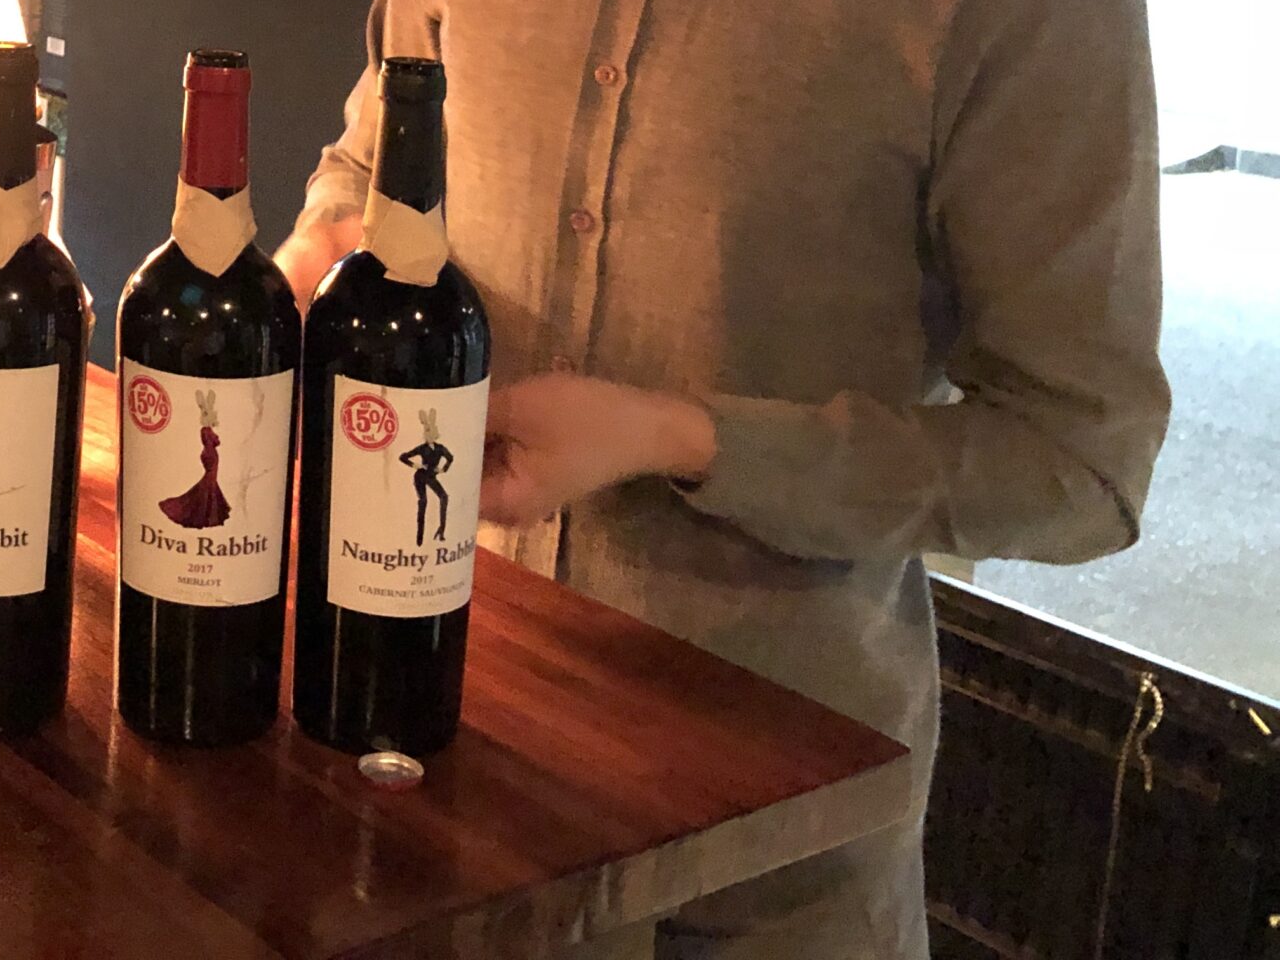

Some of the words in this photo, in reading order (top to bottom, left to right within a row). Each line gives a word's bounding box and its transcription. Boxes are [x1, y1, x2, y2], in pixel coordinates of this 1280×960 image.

[130, 390, 169, 417] 15%
[344, 407, 395, 434] 15%
[140, 523, 187, 554] Diva
[196, 533, 268, 557] Rabbit
[341, 539, 428, 572] Naughty
[187, 563, 213, 574] 2017
[177, 576, 222, 587] MERLOT
[410, 574, 434, 586] 2017
[359, 585, 416, 598] CABERNET
